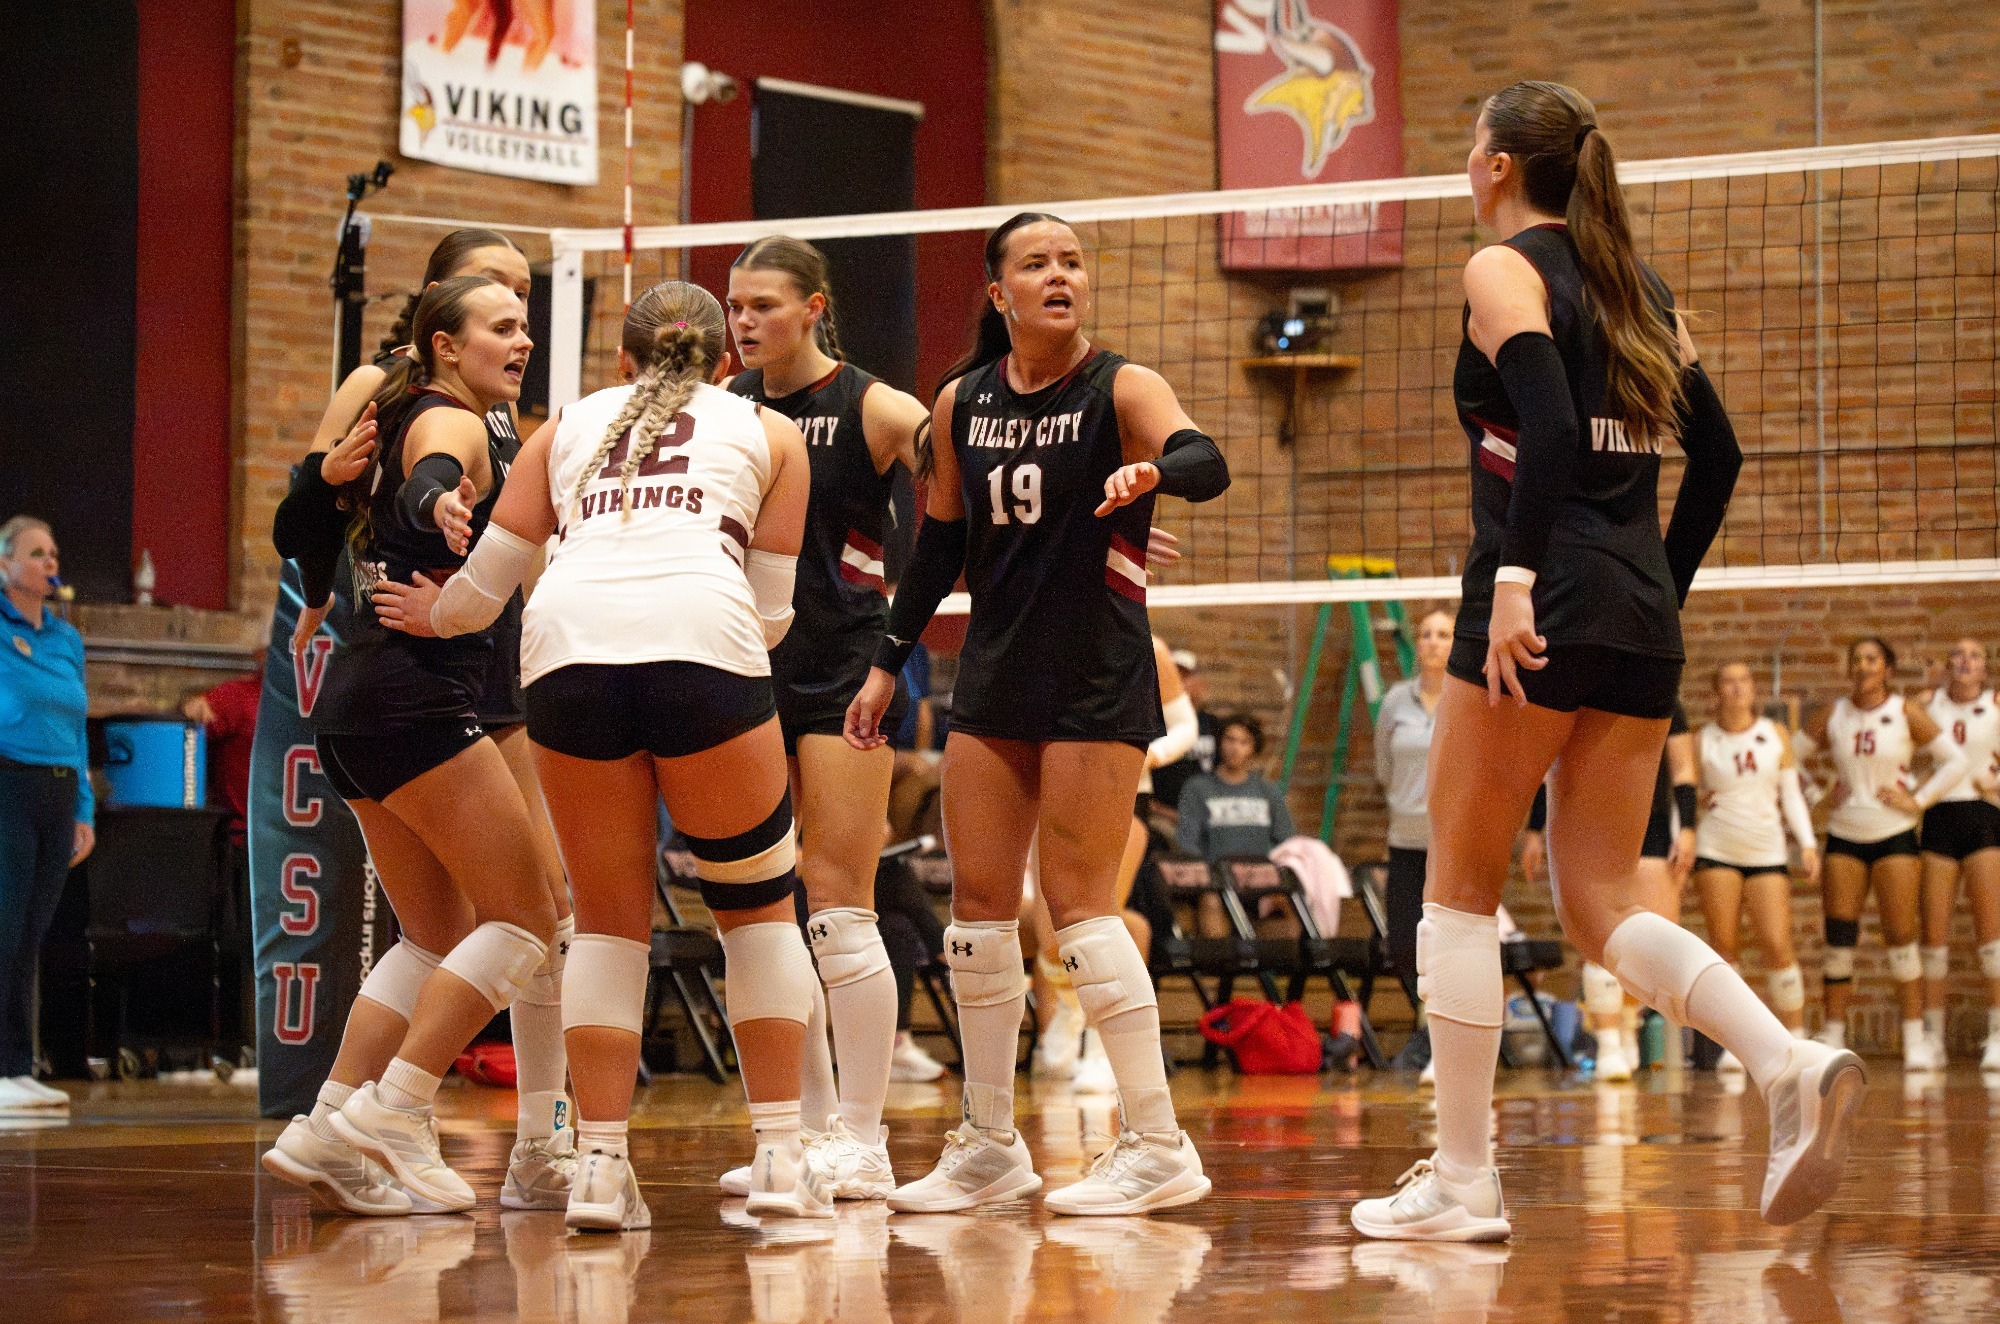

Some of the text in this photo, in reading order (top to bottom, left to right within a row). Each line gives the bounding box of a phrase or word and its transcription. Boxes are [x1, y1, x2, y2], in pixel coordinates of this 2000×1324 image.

[445, 83, 583, 134] VIKING
[446, 129, 582, 168] VOLLEYBALL
[967, 409, 1083, 449] VALLEY CITY
[581, 485, 704, 521] VIKINGS
[987, 463, 1043, 525] 19
[1854, 730, 1876, 757] 15
[359, 853, 378, 987] ports impo
